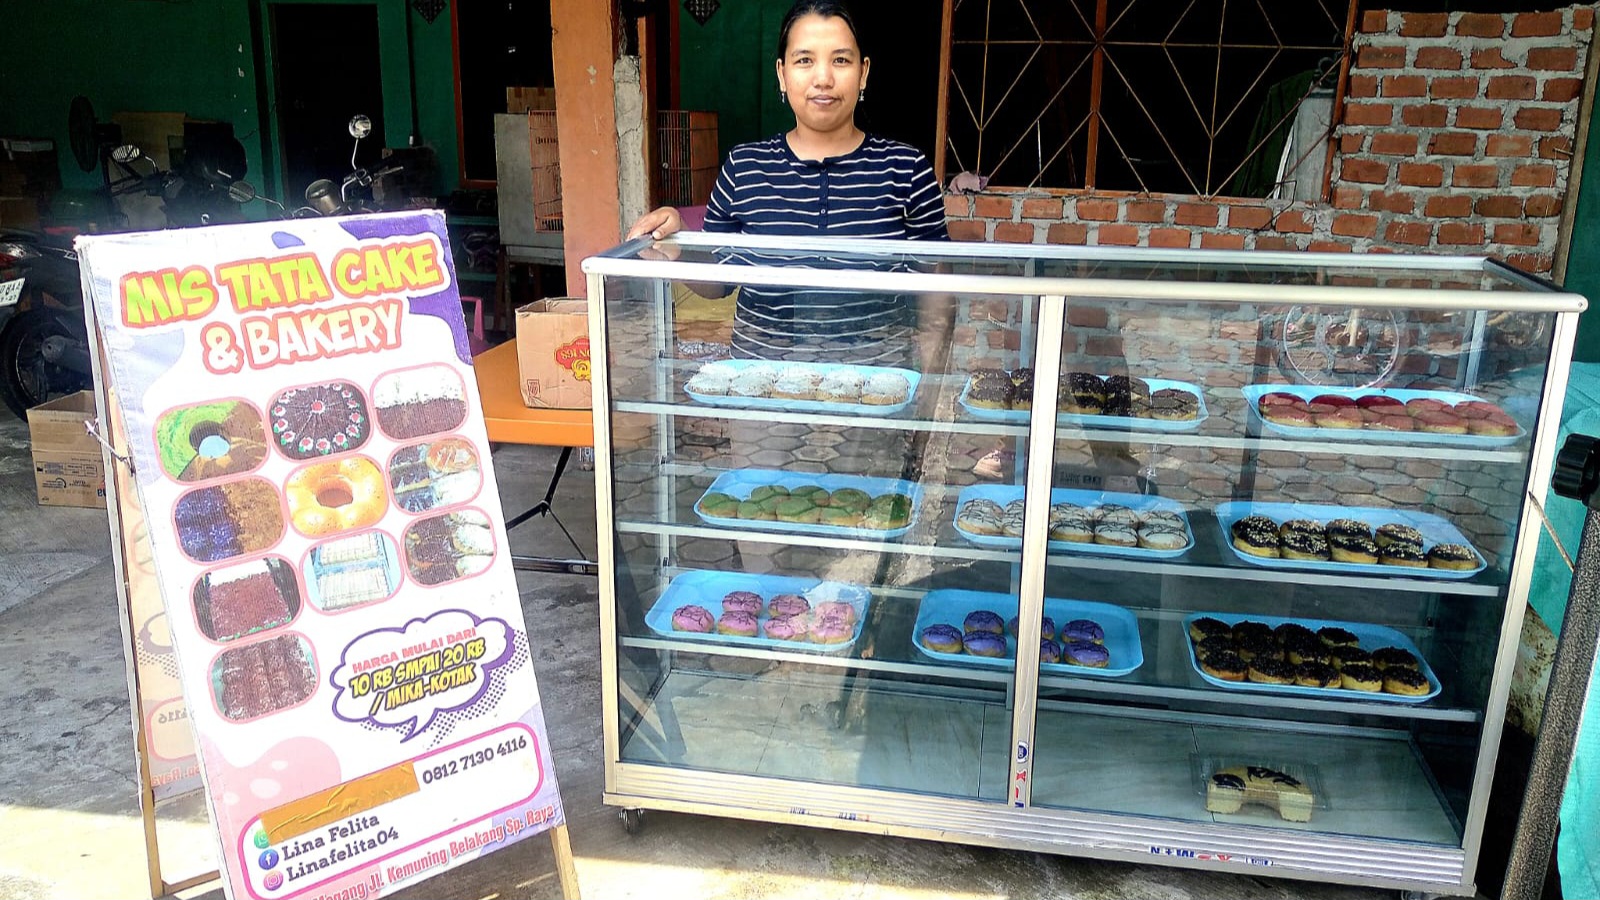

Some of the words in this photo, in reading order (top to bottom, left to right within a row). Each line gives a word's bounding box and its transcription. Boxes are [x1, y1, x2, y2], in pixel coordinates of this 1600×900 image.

[121, 266, 218, 326] MIS
[216, 254, 331, 311] TATA
[333, 241, 442, 296] CAKE
[202, 323, 243, 373] &
[243, 301, 401, 368] BAKERY
[350, 673, 371, 698] 10
[372, 666, 394, 692] RB
[395, 650, 441, 684] SMPAI
[442, 643, 465, 669] 20
[465, 637, 486, 662] RB
[352, 652, 399, 674] HARGA
[402, 637, 443, 658] MULAI
[447, 627, 477, 644] DARI
[385, 663, 477, 710] MIKA-KOTAK
[422, 760, 459, 784] 0812
[459, 747, 494, 770] 7130
[496, 735, 527, 756] 4116
[281, 837, 325, 861] Lina
[328, 815, 380, 842] Felita
[286, 826, 399, 882] Linafelita04
[386, 852, 447, 884] Kemuning
[449, 824, 505, 858] Belakang
[505, 817, 524, 836] Sp.
[525, 805, 554, 827] Raya
